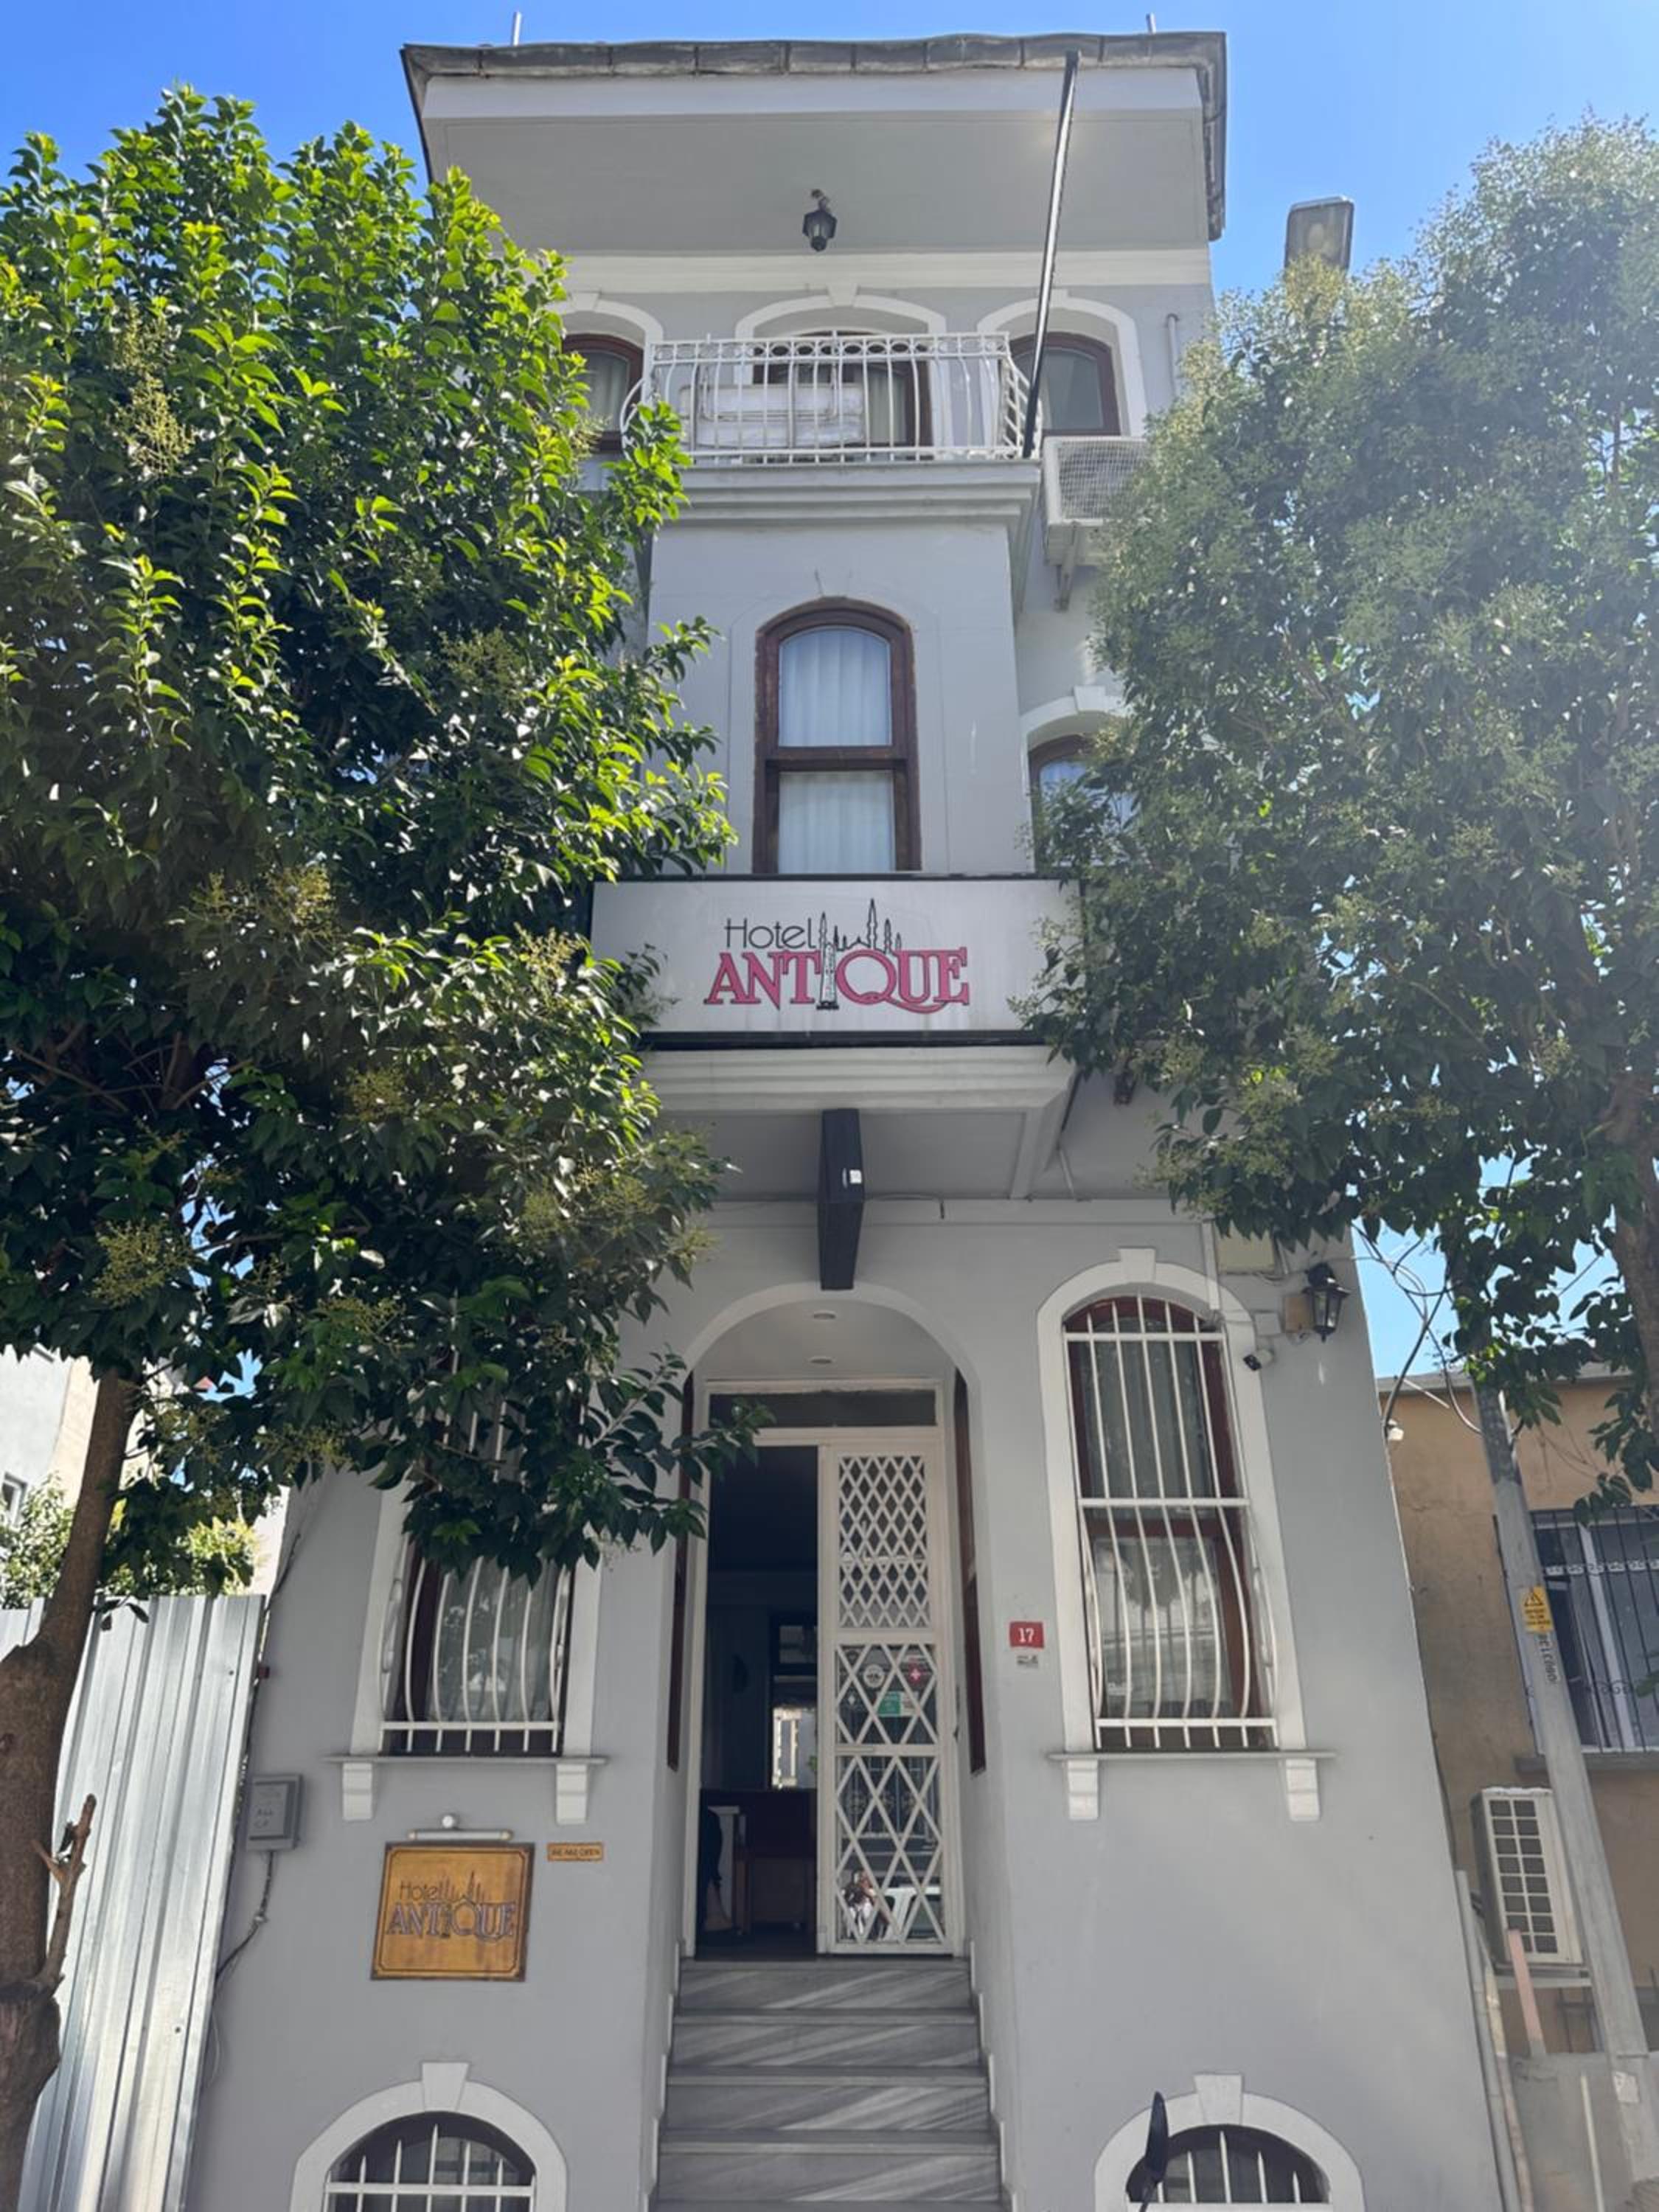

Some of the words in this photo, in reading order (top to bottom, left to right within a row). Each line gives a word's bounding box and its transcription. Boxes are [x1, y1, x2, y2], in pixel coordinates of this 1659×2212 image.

[724, 917, 817, 949] Hotel
[703, 947, 970, 1015] ANTIQUE
[1018, 1627, 1035, 1644] 17
[399, 1880, 443, 1902] Hotel
[386, 1901, 516, 1942] ANTIQUE
